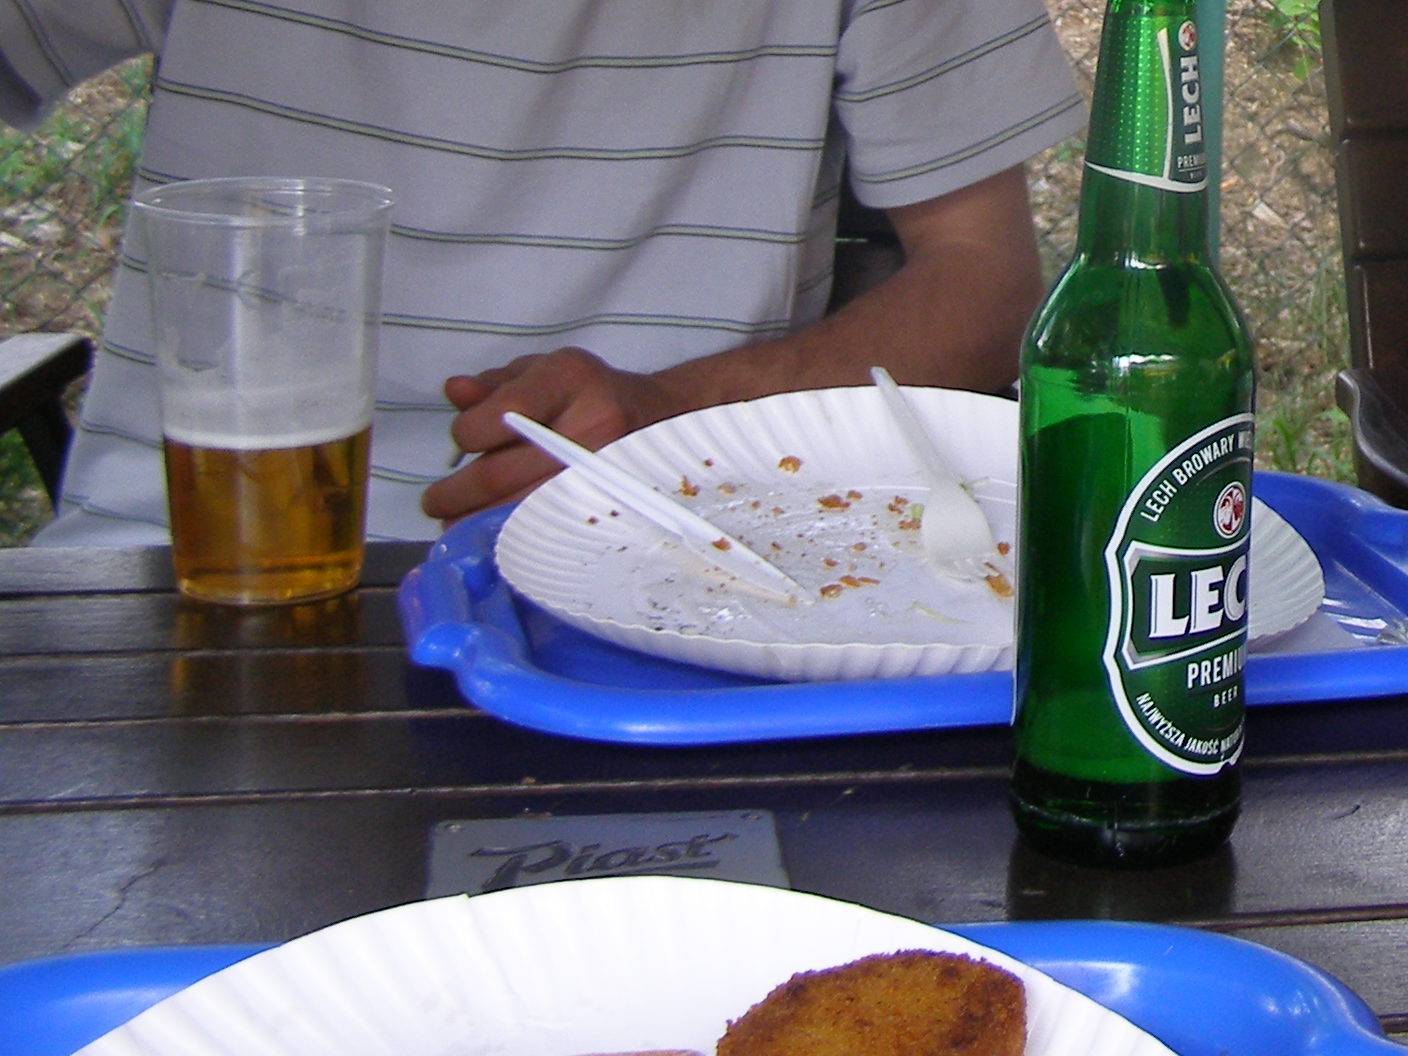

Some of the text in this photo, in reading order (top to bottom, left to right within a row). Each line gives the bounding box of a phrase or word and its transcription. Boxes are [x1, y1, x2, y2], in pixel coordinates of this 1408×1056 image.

[1179, 54, 1203, 145] LECH
[1140, 479, 1178, 522] LECH
[1172, 433, 1235, 485] BROWARY
[1136, 692, 1186, 747] NAJWYŻSZA
[1213, 685, 1238, 708] BEER
[470, 831, 739, 892] Piast
